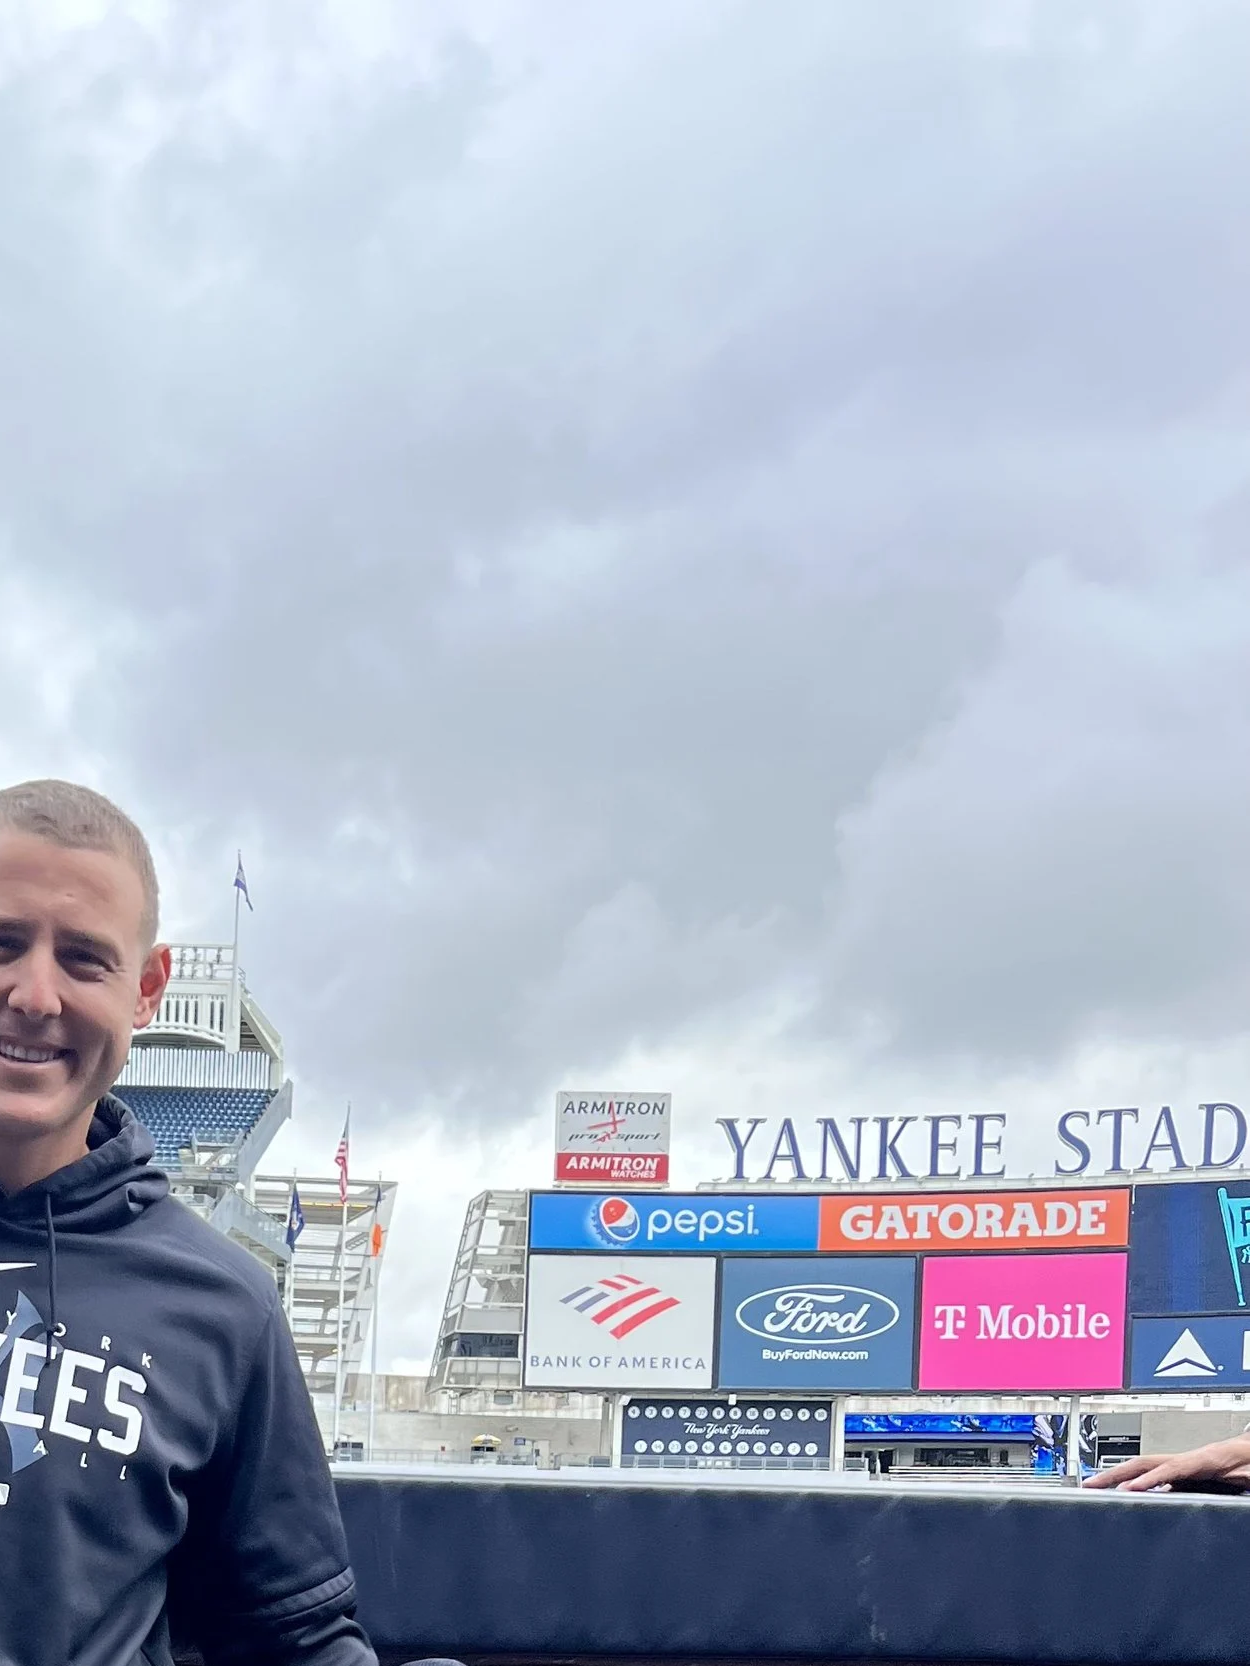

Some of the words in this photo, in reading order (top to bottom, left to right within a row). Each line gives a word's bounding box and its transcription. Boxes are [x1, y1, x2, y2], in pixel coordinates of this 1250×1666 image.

[563, 1100, 666, 1115] ARMITRON
[714, 1111, 1008, 1181] YANKEE
[1053, 1101, 1250, 1176] STAD
[565, 1156, 658, 1171] ARMITRON
[610, 1169, 656, 1179] WATCHES
[647, 1204, 755, 1242] pepsi
[839, 1200, 1107, 1241] GATORADE
[763, 1291, 867, 1336] Ford
[977, 1303, 1111, 1340] Mobile
[530, 1355, 583, 1370] BANK
[587, 1356, 612, 1370] OF
[615, 1356, 707, 1370] AMERICA
[762, 1348, 869, 1361] BuyFordNow.com
[683, 1422, 706, 1434] New
[705, 1423, 730, 1439] York
[730, 1423, 770, 1440] Yankees
